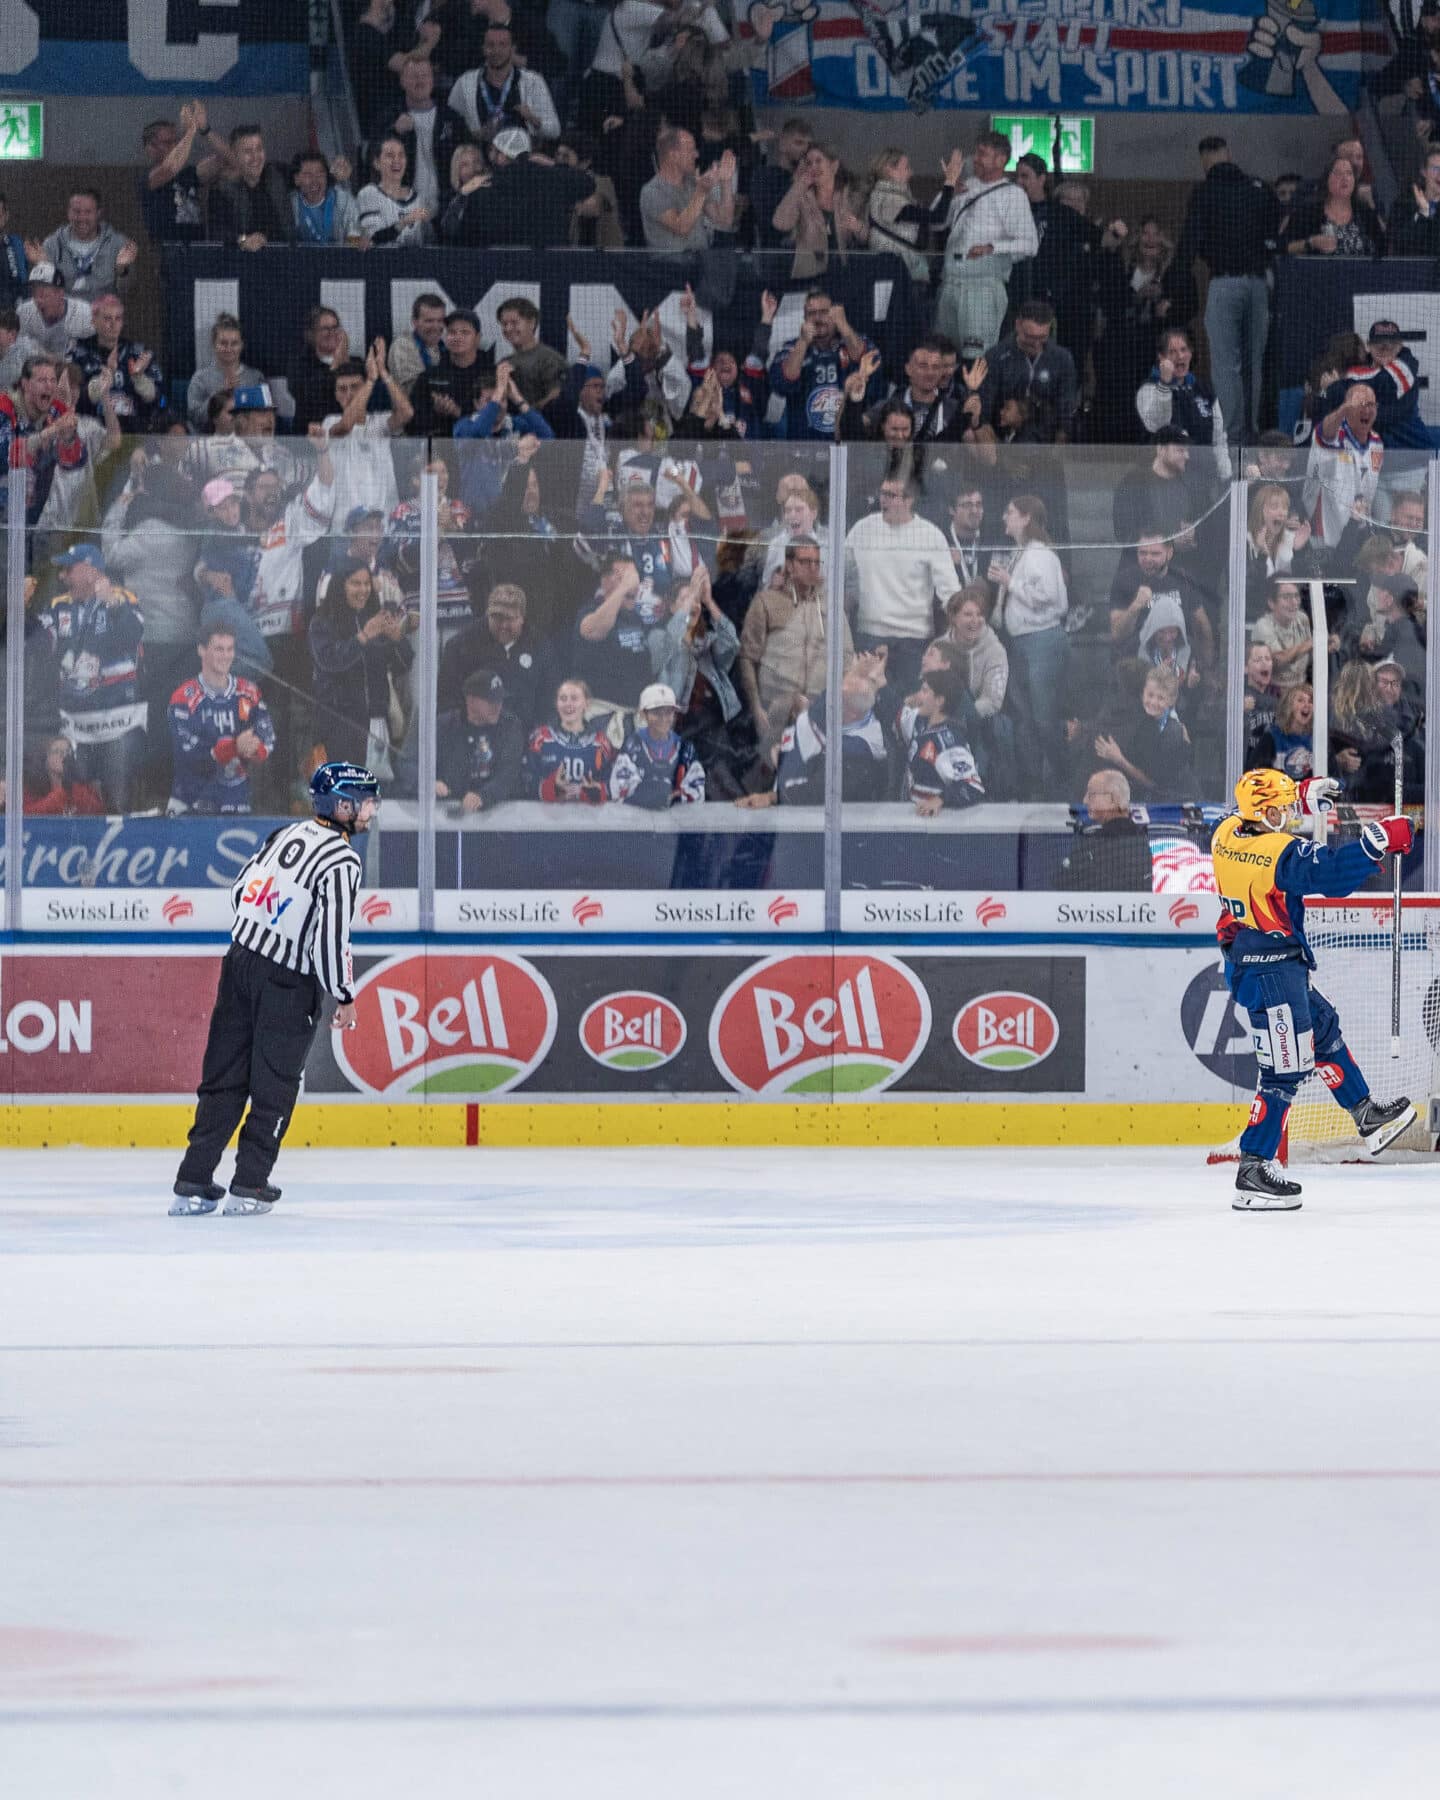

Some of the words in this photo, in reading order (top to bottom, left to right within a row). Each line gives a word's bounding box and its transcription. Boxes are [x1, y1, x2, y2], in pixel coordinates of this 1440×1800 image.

[1084, 51, 1244, 107] SPORT
[0, 815, 189, 888] rcher
[47, 900, 150, 922] SwissLife
[243, 876, 293, 925] sky
[458, 901, 560, 923] SwissLife
[655, 901, 756, 923] SwissLife
[863, 902, 964, 924] SwissLife
[1057, 902, 1157, 924] SwissLife
[1242, 953, 1288, 964] BAUER
[0, 1000, 92, 1054] ON
[376, 964, 510, 1072] Bell
[603, 1005, 662, 1049] Bell
[754, 964, 884, 1072] Bell
[977, 1005, 1035, 1049] Bell
